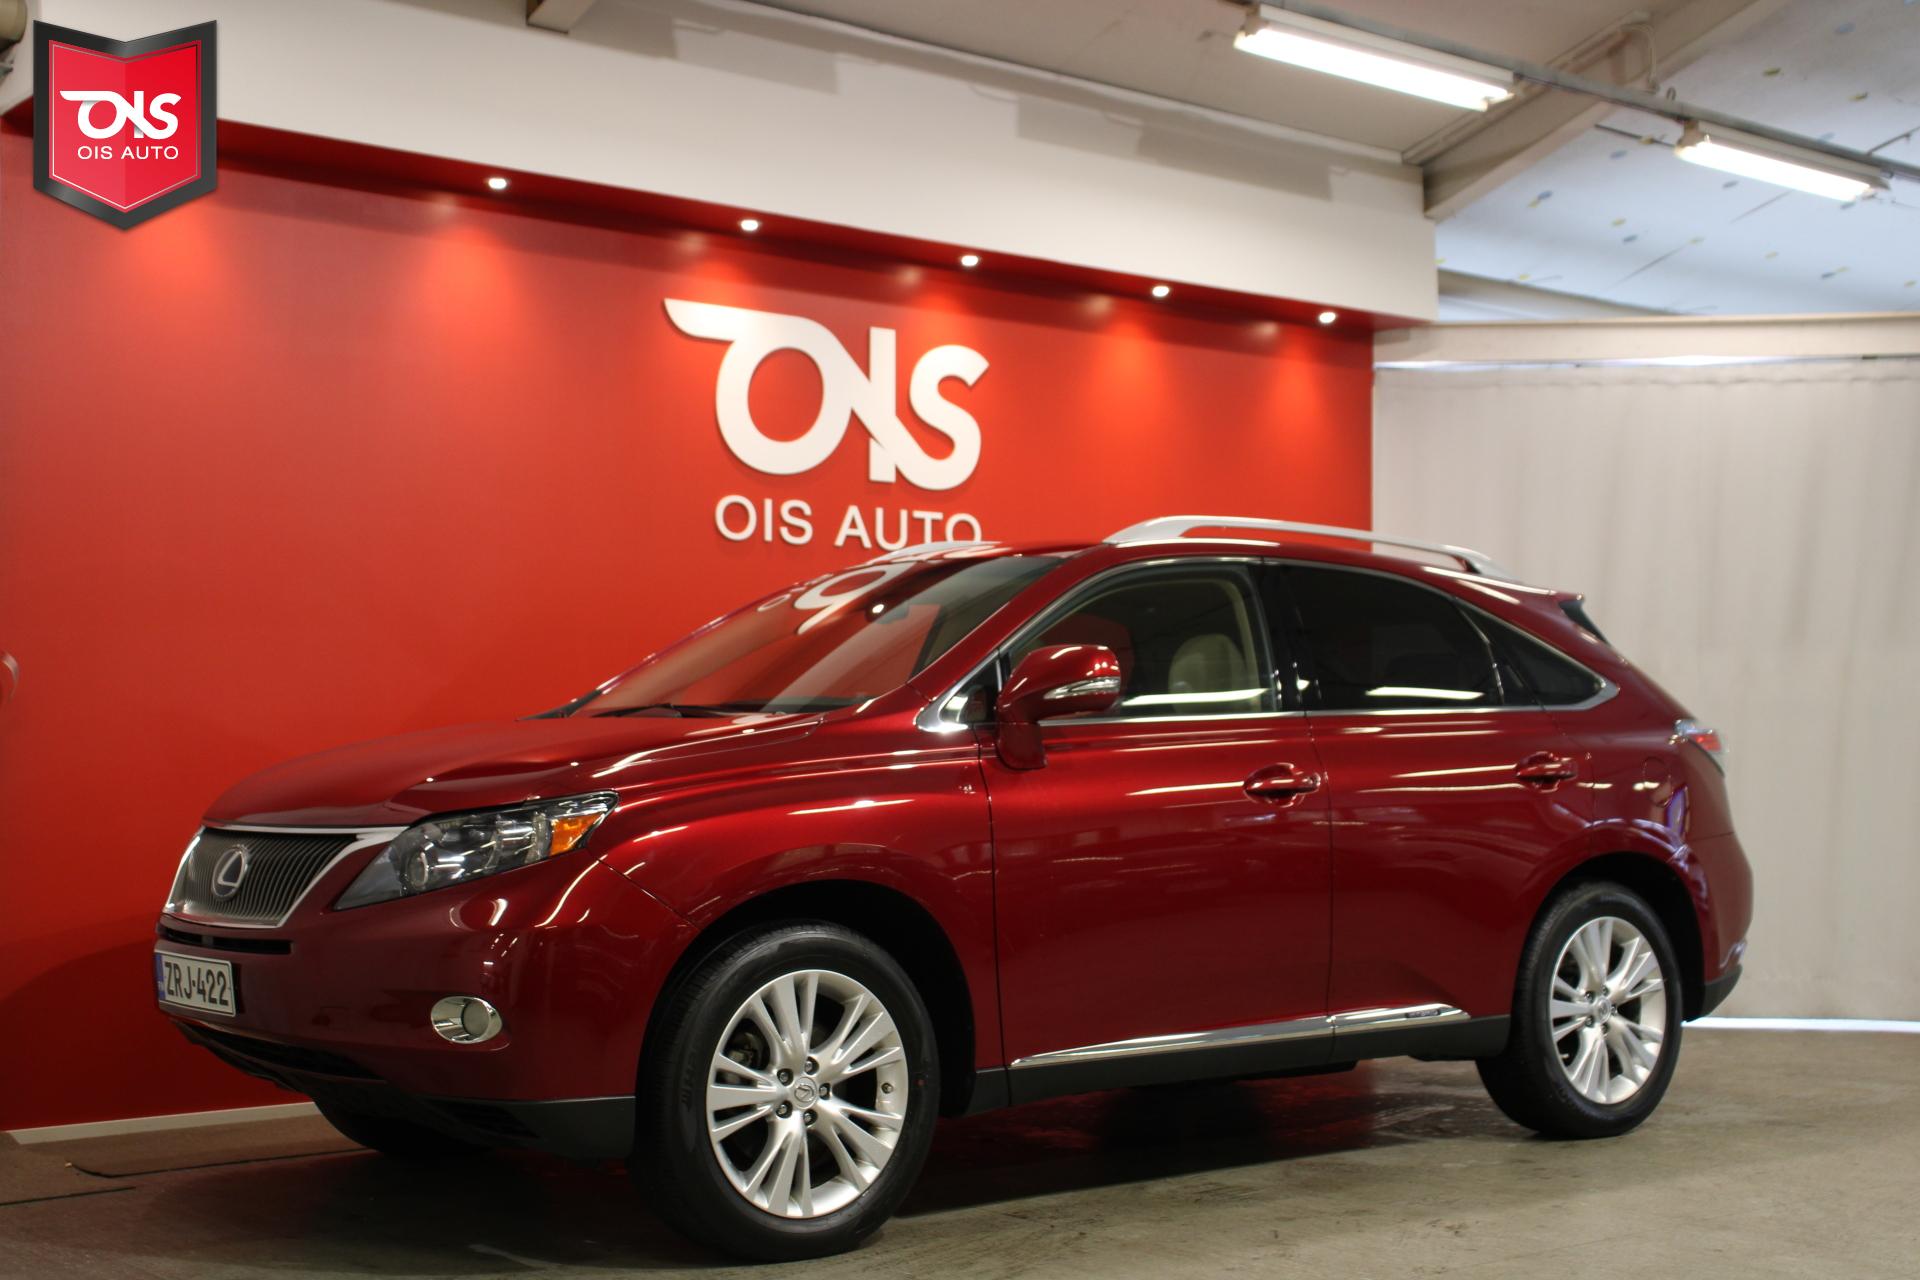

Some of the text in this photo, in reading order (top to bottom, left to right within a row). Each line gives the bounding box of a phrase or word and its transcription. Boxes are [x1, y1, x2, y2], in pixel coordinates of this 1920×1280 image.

[664, 298, 990, 491] OIS
[715, 495, 982, 551] OIS AUTO
[164, 962, 229, 1006] ZRJ-422
